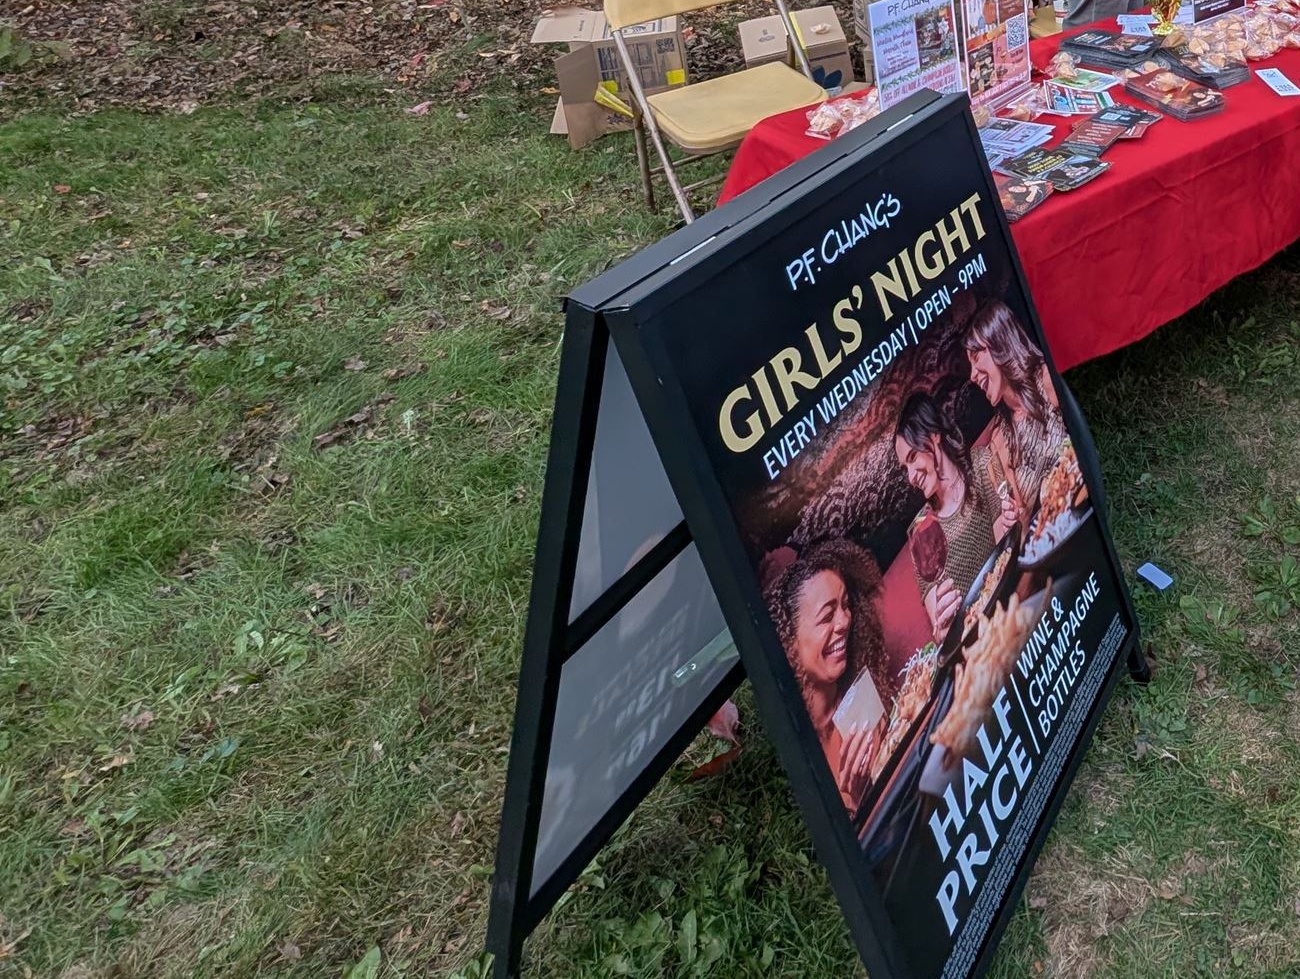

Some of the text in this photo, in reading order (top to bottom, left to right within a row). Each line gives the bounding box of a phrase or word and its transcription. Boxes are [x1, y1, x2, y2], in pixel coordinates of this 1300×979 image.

[887, 4, 899, 17] P.F.
[785, 193, 901, 291] P.F. CHANG'S
[870, 192, 987, 321] NIGHT
[762, 409, 817, 480] EVERY
[816, 323, 908, 424] WEDNESDAY
[914, 285, 952, 331] OPEN
[958, 253, 987, 291] 9PM
[1016, 596, 1065, 679] WINE &
[1028, 572, 1101, 707] CHAMPAGNE
[1037, 640, 1086, 738] BOTTLES
[928, 685, 1013, 863] HALF
[936, 735, 1033, 937] PRICE
